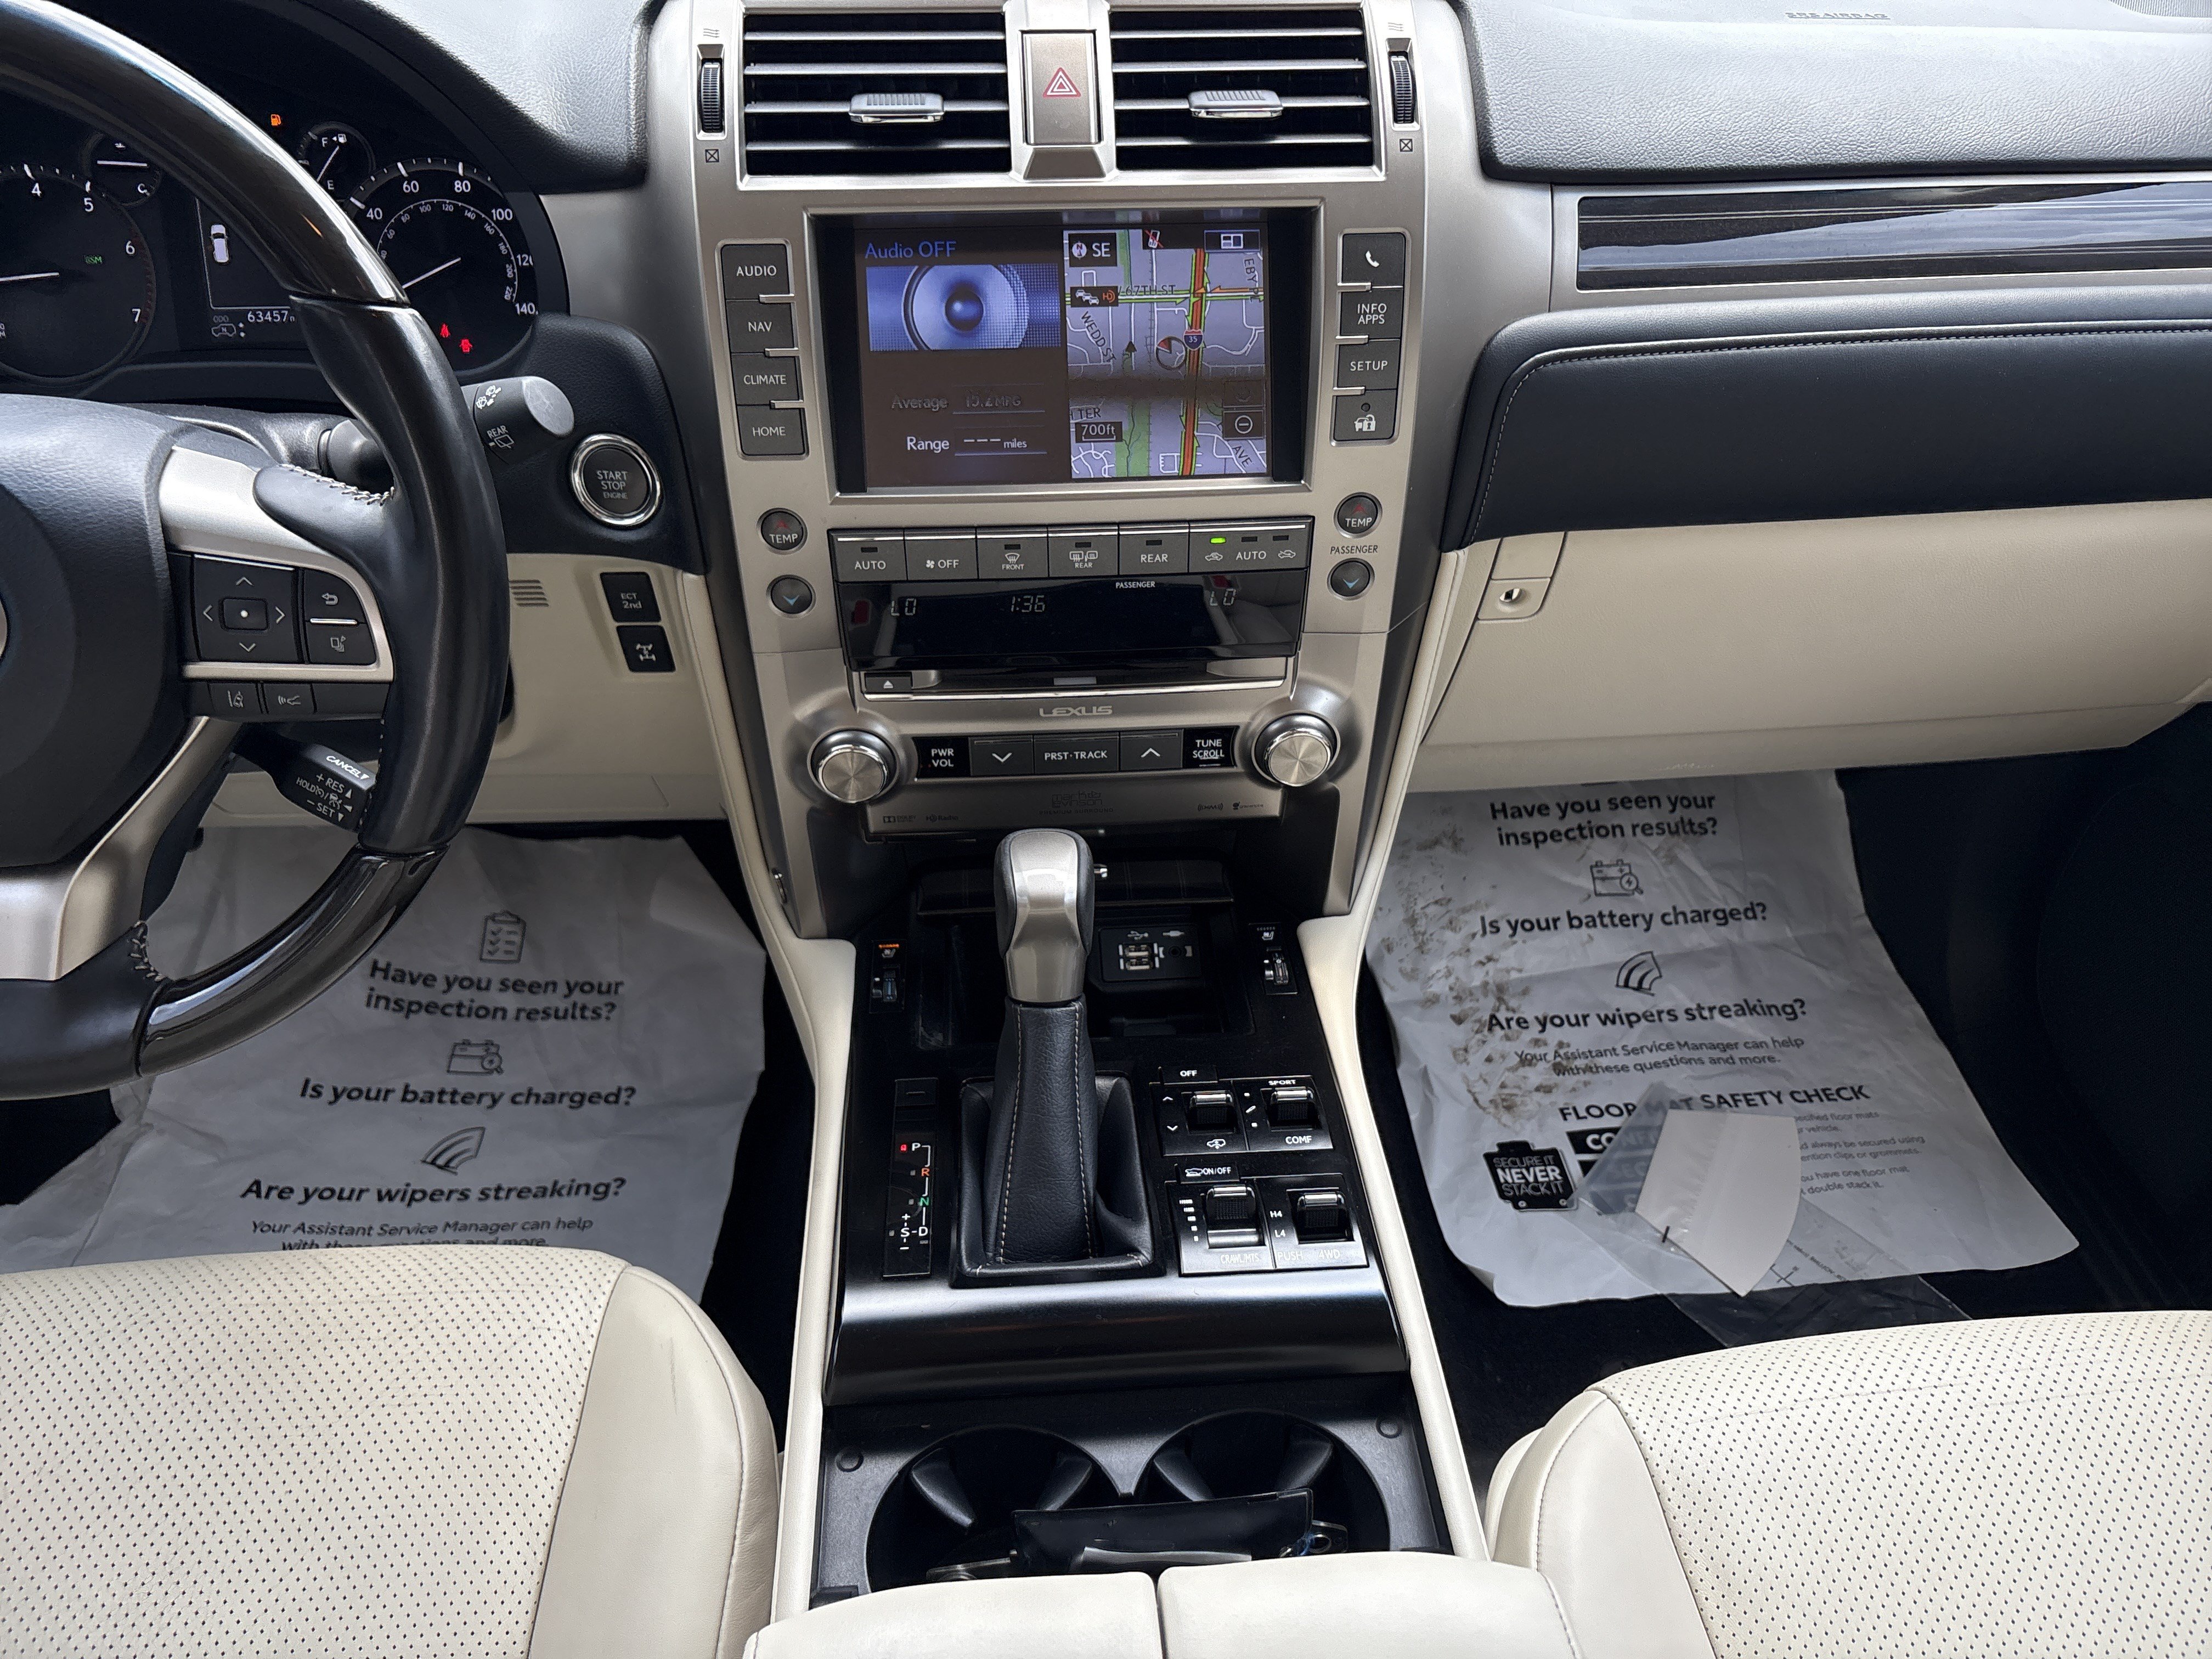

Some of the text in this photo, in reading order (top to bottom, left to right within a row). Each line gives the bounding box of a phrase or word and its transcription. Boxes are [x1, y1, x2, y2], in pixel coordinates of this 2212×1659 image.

[322, 137, 328, 147] F
[31, 184, 41, 197] 4
[328, 180, 334, 190] E
[403, 181, 419, 194] 60
[454, 181, 471, 194] 80
[84, 199, 94, 212] 5
[420, 204, 432, 213] 100
[442, 204, 454, 212] 120
[366, 208, 382, 220] 40
[464, 210, 476, 221] 140
[490, 208, 513, 221] 100
[484, 222, 495, 235] 160
[126, 241, 135, 255] 6
[865, 241, 957, 259] Audio OFF
[1092, 242, 1111, 257] SE
[736, 265, 777, 276] AUDIO
[1244, 258, 1257, 283] EBY
[1126, 285, 1157, 296] 67TH
[1161, 285, 1176, 295] ST
[515, 303, 535, 315] 140
[1357, 303, 1387, 314] INFO
[132, 309, 142, 322] 7
[1358, 314, 1385, 325] APPS
[748, 321, 772, 332] NAV
[1081, 311, 1117, 364] WEDD ST
[1350, 361, 1388, 371] SETUP
[743, 375, 787, 385] CLIMATE
[891, 394, 948, 411] Average
[1078, 408, 1101, 419] TER
[487, 425, 509, 438] REAR
[753, 427, 786, 437] HOME
[1081, 424, 1115, 436] 700ft
[907, 437, 1027, 453] Range miles
[1232, 446, 1252, 467] AVE
[596, 470, 628, 481] START
[601, 480, 625, 490] STOP
[603, 492, 629, 500] ENGINE
[1345, 517, 1372, 528] TEMP
[769, 533, 798, 544] TEMP
[1236, 551, 1267, 560] AUTO
[1330, 545, 1379, 555] PASSENGER
[938, 559, 960, 569] OFF
[1140, 554, 1168, 563] REAR
[854, 561, 886, 570] AUTO
[623, 601, 642, 609] 2nd
[1011, 595, 1045, 612] 1:36
[1039, 706, 1113, 718] LEXUS
[1195, 739, 1222, 748] TUNE
[931, 748, 955, 758] PWR
[1192, 749, 1224, 758] SCROLL
[326, 755, 361, 778] CANCEL
[932, 758, 954, 768] VOL
[296, 777, 315, 793] HOLD
[325, 777, 345, 793] RES
[316, 802, 335, 818] SET
[1490, 793, 1717, 820] Have you seen your
[1496, 816, 1719, 849] inspection results?
[1480, 901, 1768, 938] Is your battery charged?
[369, 960, 625, 998] Have you seen your
[364, 988, 618, 1022] inspection results?
[1487, 997, 1808, 1032] Are your wipers streaking?
[1514, 1036, 1804, 1064] Your Assistant Service Manager can help
[1585, 1062, 1630, 1075] these
[1634, 1057, 1705, 1073] questions
[1709, 1054, 1736, 1065] and
[1739, 1053, 1781, 1065] more.
[300, 1078, 637, 1109] Is your battery charged?
[1701, 1090, 1783, 1110] SAFETY
[1789, 1085, 1871, 1103] CHECK
[1285, 1136, 1312, 1144] COMF
[912, 1143, 921, 1151] P
[1493, 1155, 1555, 1169] SECURE IT
[921, 1168, 930, 1177] R
[1496, 1166, 1563, 1183] NEVER
[240, 1177, 627, 1209] Are your wipers streaking?
[1502, 1181, 1564, 1197] STACK IT
[919, 1198, 929, 1206] N
[252, 1218, 594, 1238] Your Assistant Service Manager can help
[1277, 1249, 1341, 1261] PUSH 4WD
